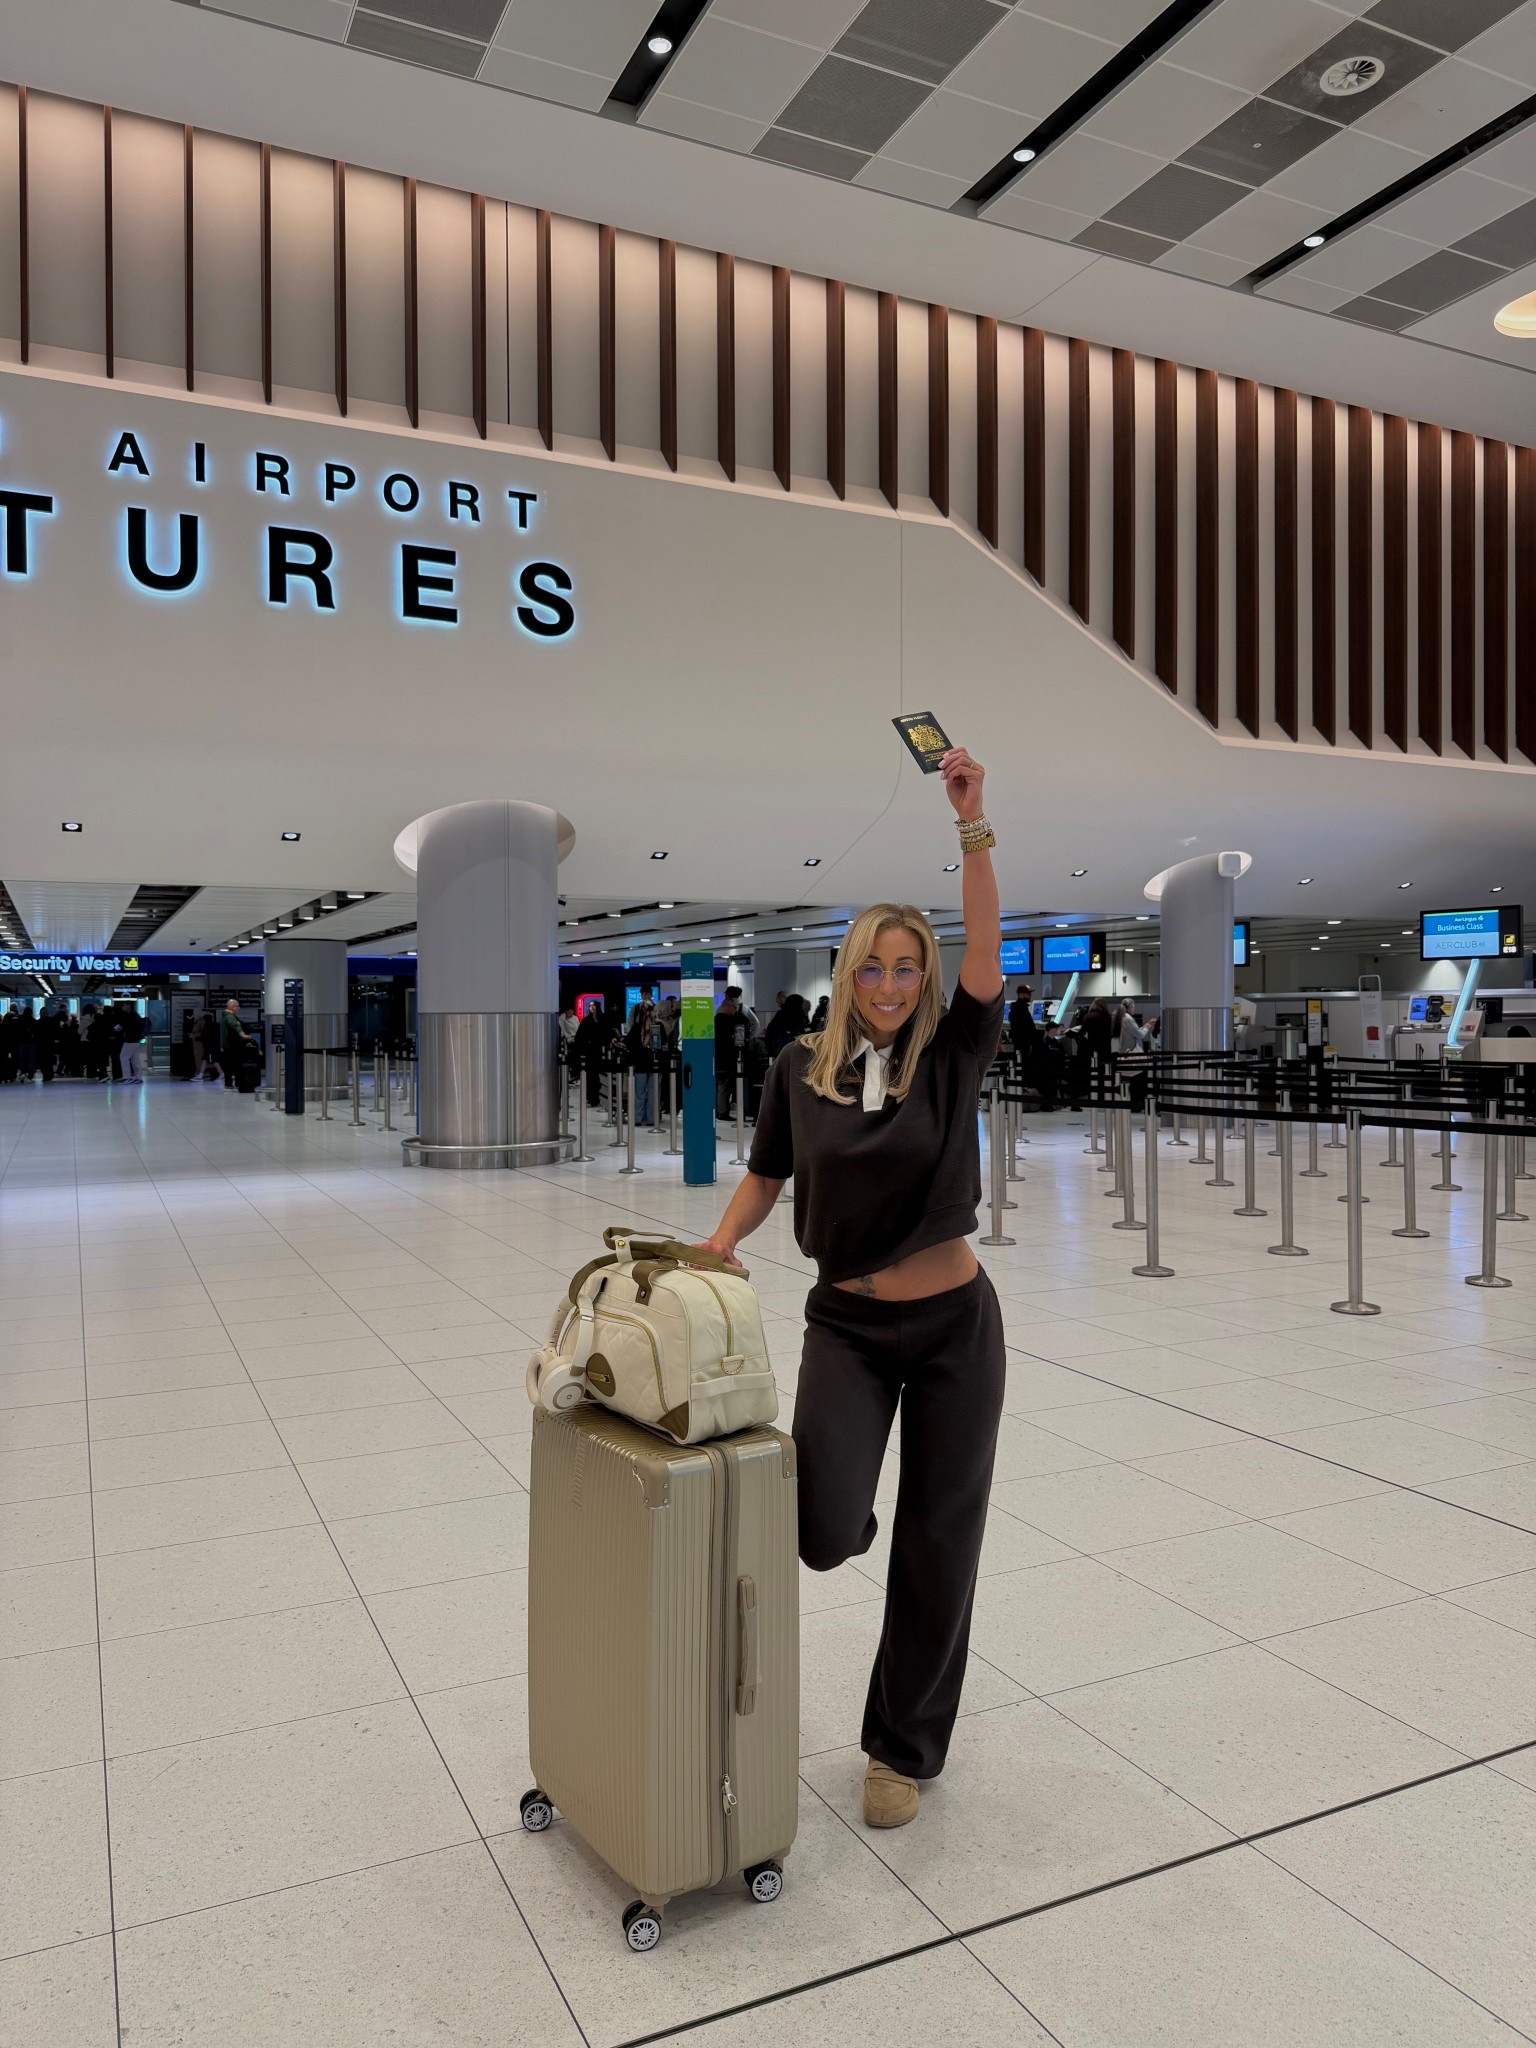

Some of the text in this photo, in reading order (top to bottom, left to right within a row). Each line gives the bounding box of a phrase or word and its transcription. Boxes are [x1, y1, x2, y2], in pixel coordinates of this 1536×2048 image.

[108, 432, 537, 529] AIRPORT
[0, 490, 575, 637] TURES
[1437, 924, 1465, 932] Business
[1436, 940, 1477, 949] AERCLUB
[0, 955, 121, 973] Security West
